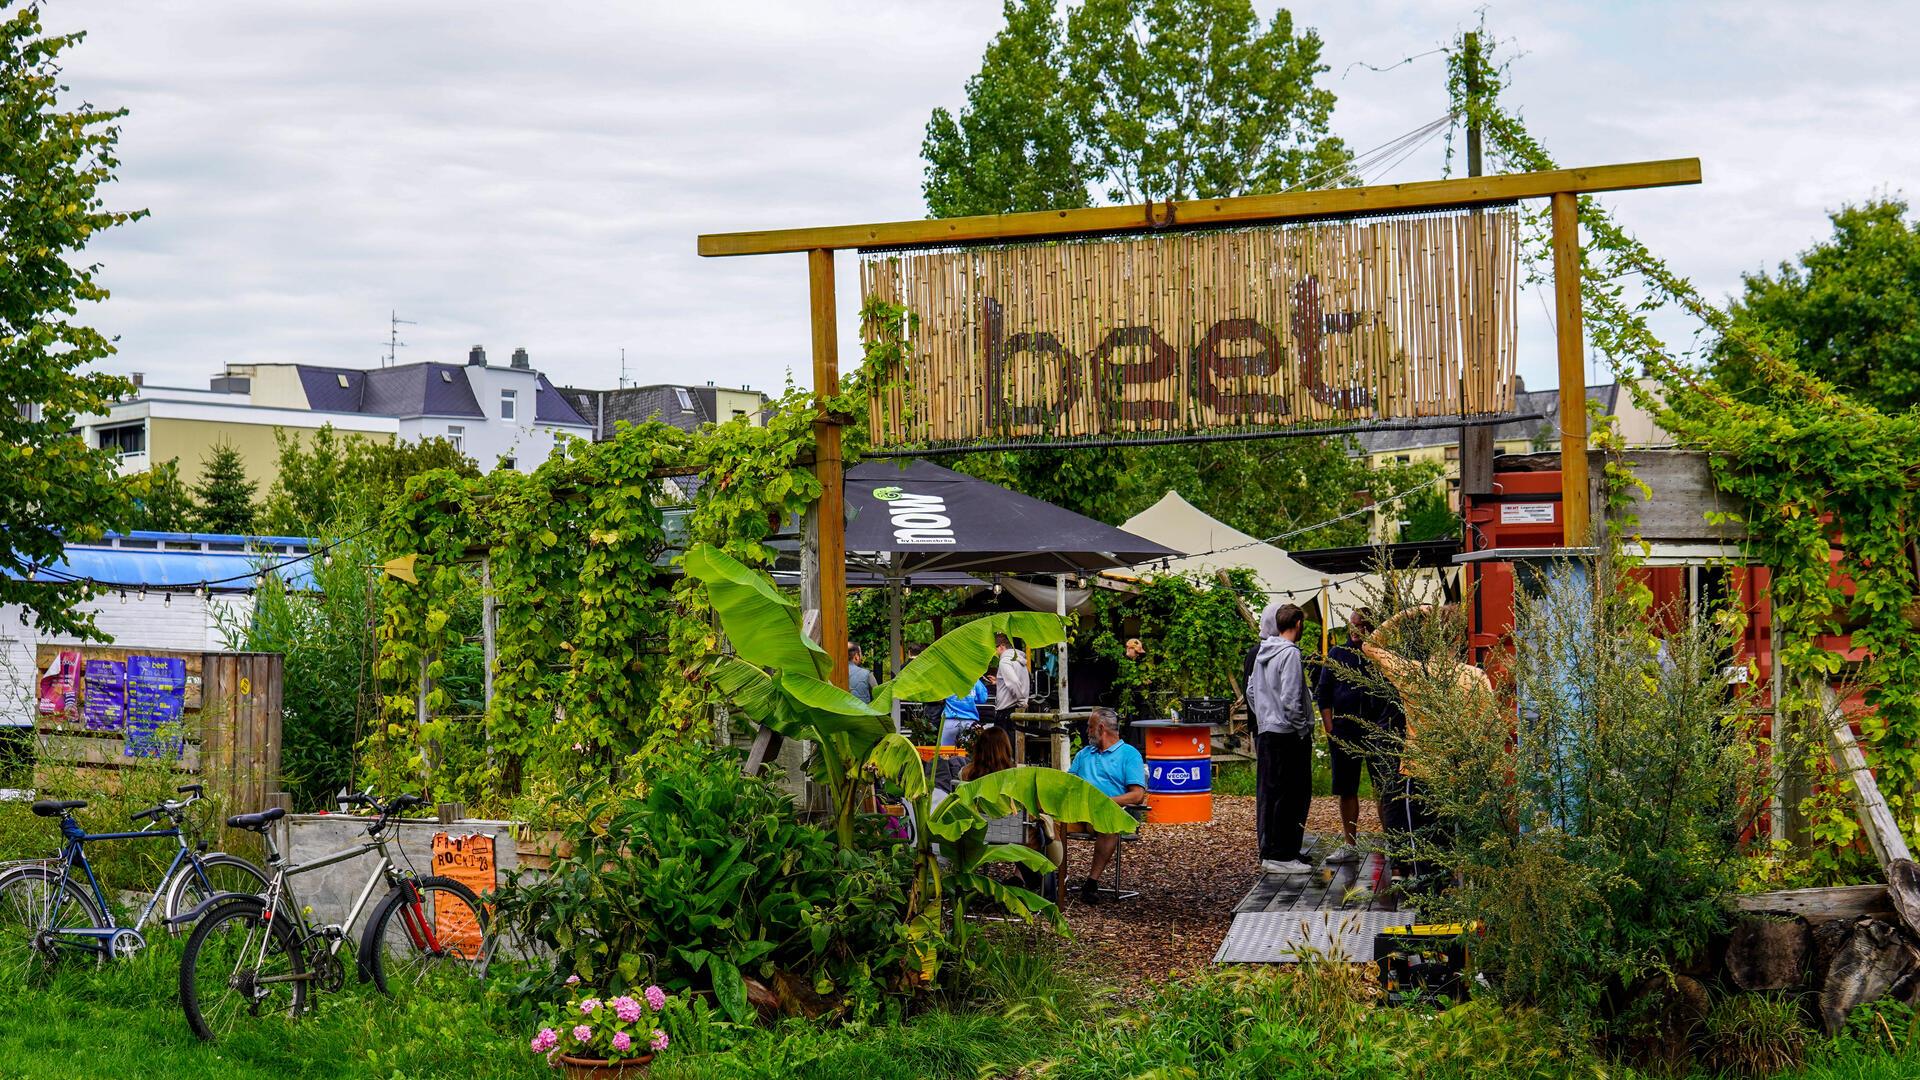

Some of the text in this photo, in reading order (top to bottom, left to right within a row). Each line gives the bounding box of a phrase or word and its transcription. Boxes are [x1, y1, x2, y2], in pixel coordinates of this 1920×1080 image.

[983, 274, 1372, 430] beet
[888, 493, 957, 544] now
[151, 661, 168, 669] beet
[438, 852, 476, 869] ROCKT
